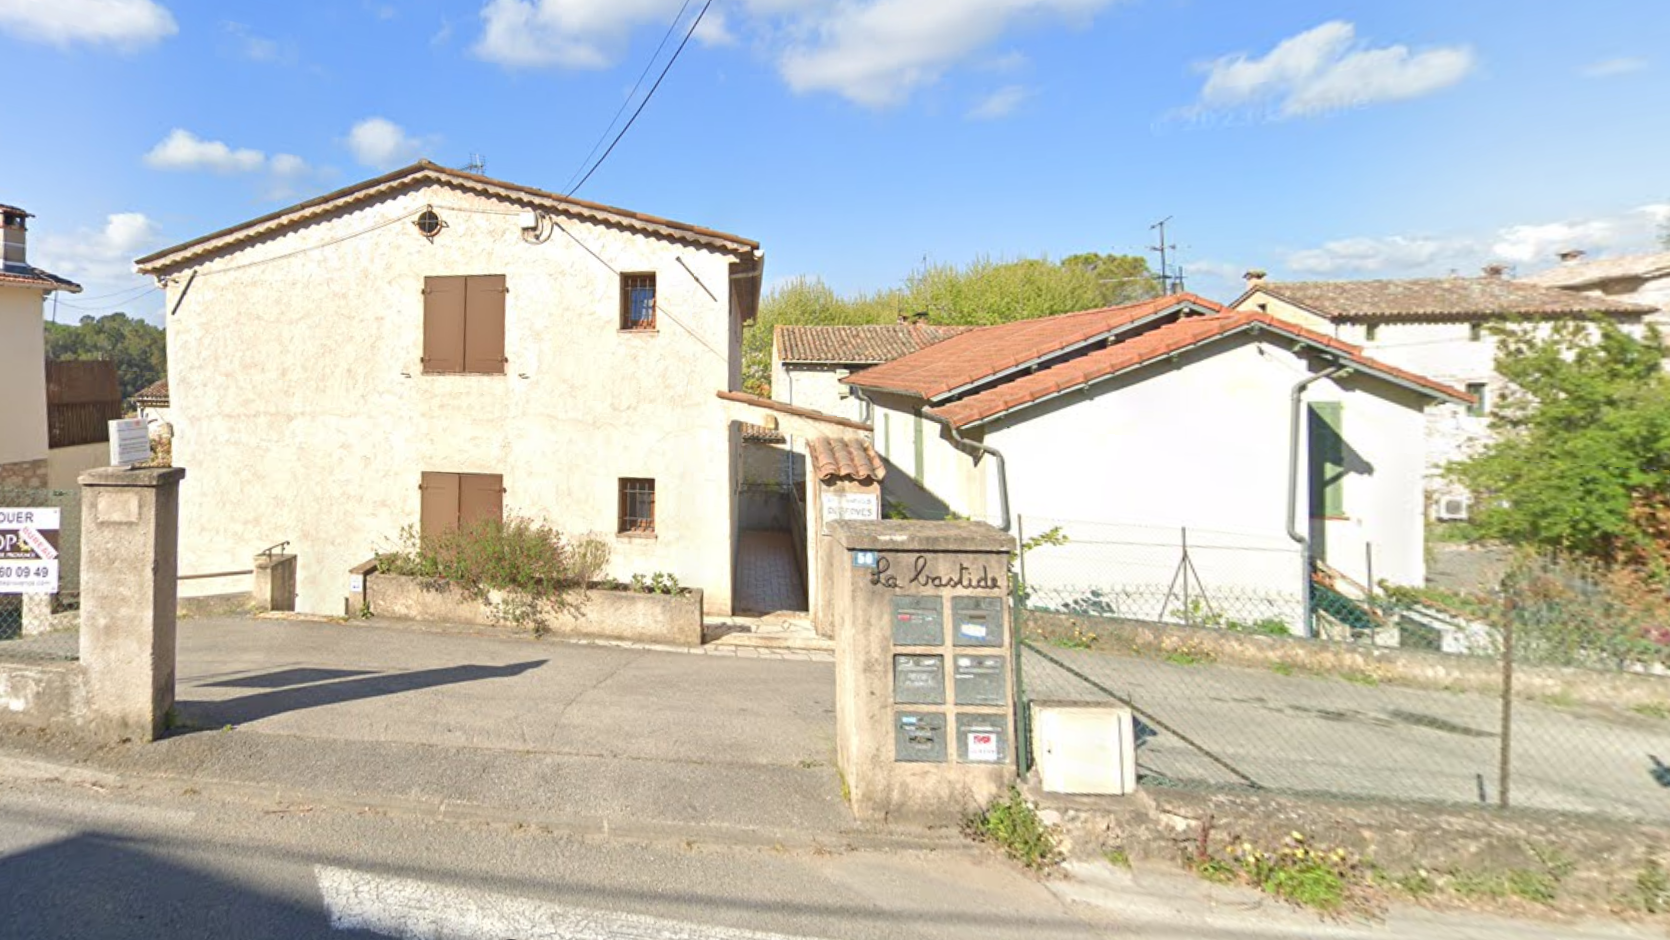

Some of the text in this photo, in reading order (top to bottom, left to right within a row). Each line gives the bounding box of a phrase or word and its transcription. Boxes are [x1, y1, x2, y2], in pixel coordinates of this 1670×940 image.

[15, 566, 30, 578] 09
[33, 566, 49, 578] 49
[870, 555, 1000, 589] La bastide
